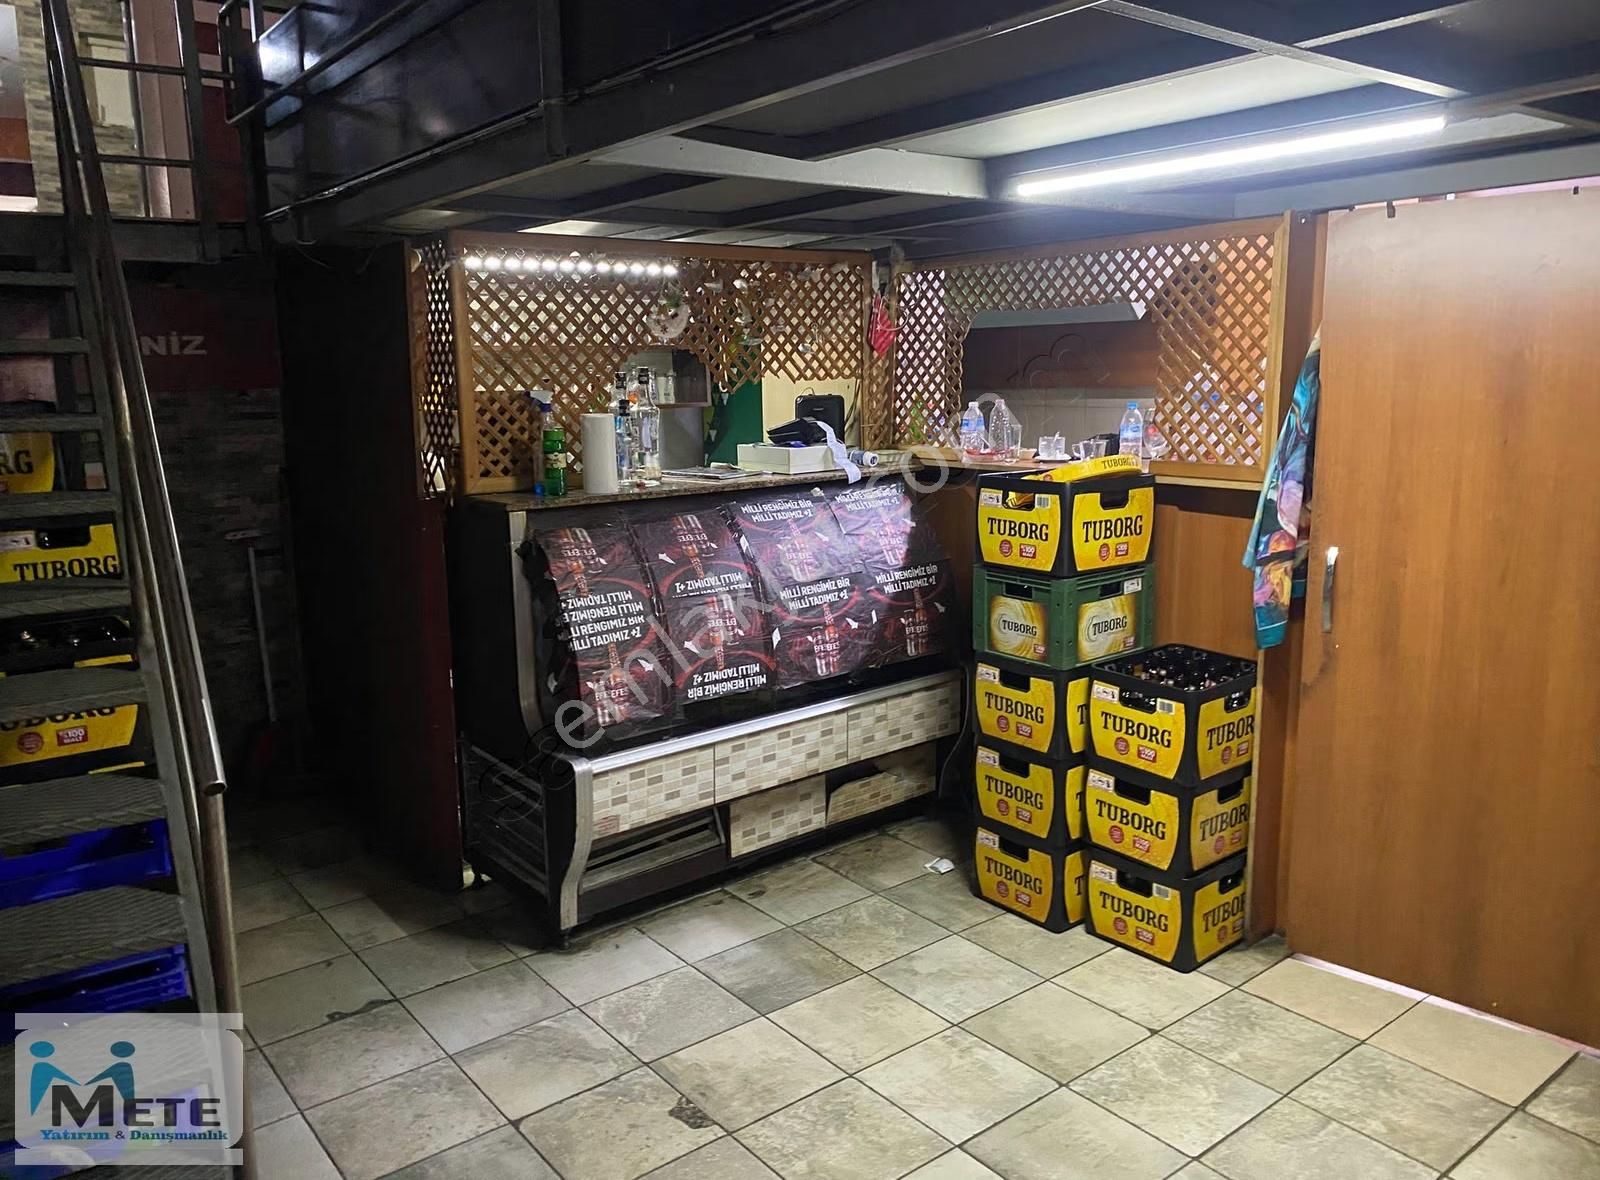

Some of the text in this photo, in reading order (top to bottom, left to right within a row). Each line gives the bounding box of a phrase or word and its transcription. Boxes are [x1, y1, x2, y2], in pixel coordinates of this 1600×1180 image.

[987, 517, 1049, 542] TUBORG
[1082, 515, 1143, 543] TUBORG
[13, 555, 120, 581] TUBORG
[570, 636, 591, 651] İLLİ
[1002, 619, 1037, 637] TUBORG
[1092, 615, 1127, 636] TUBORG
[984, 691, 1044, 724] TUBORG
[1101, 711, 1171, 748] TUBORG
[1207, 714, 1255, 750] TUBOR
[984, 774, 1043, 810] TUBORG
[1096, 799, 1166, 840] TUBORG
[1200, 803, 1249, 842] TUBOR
[984, 855, 1042, 895] TUBORG
[1099, 891, 1168, 932] TUBORG
[1203, 893, 1245, 933] TUBO
